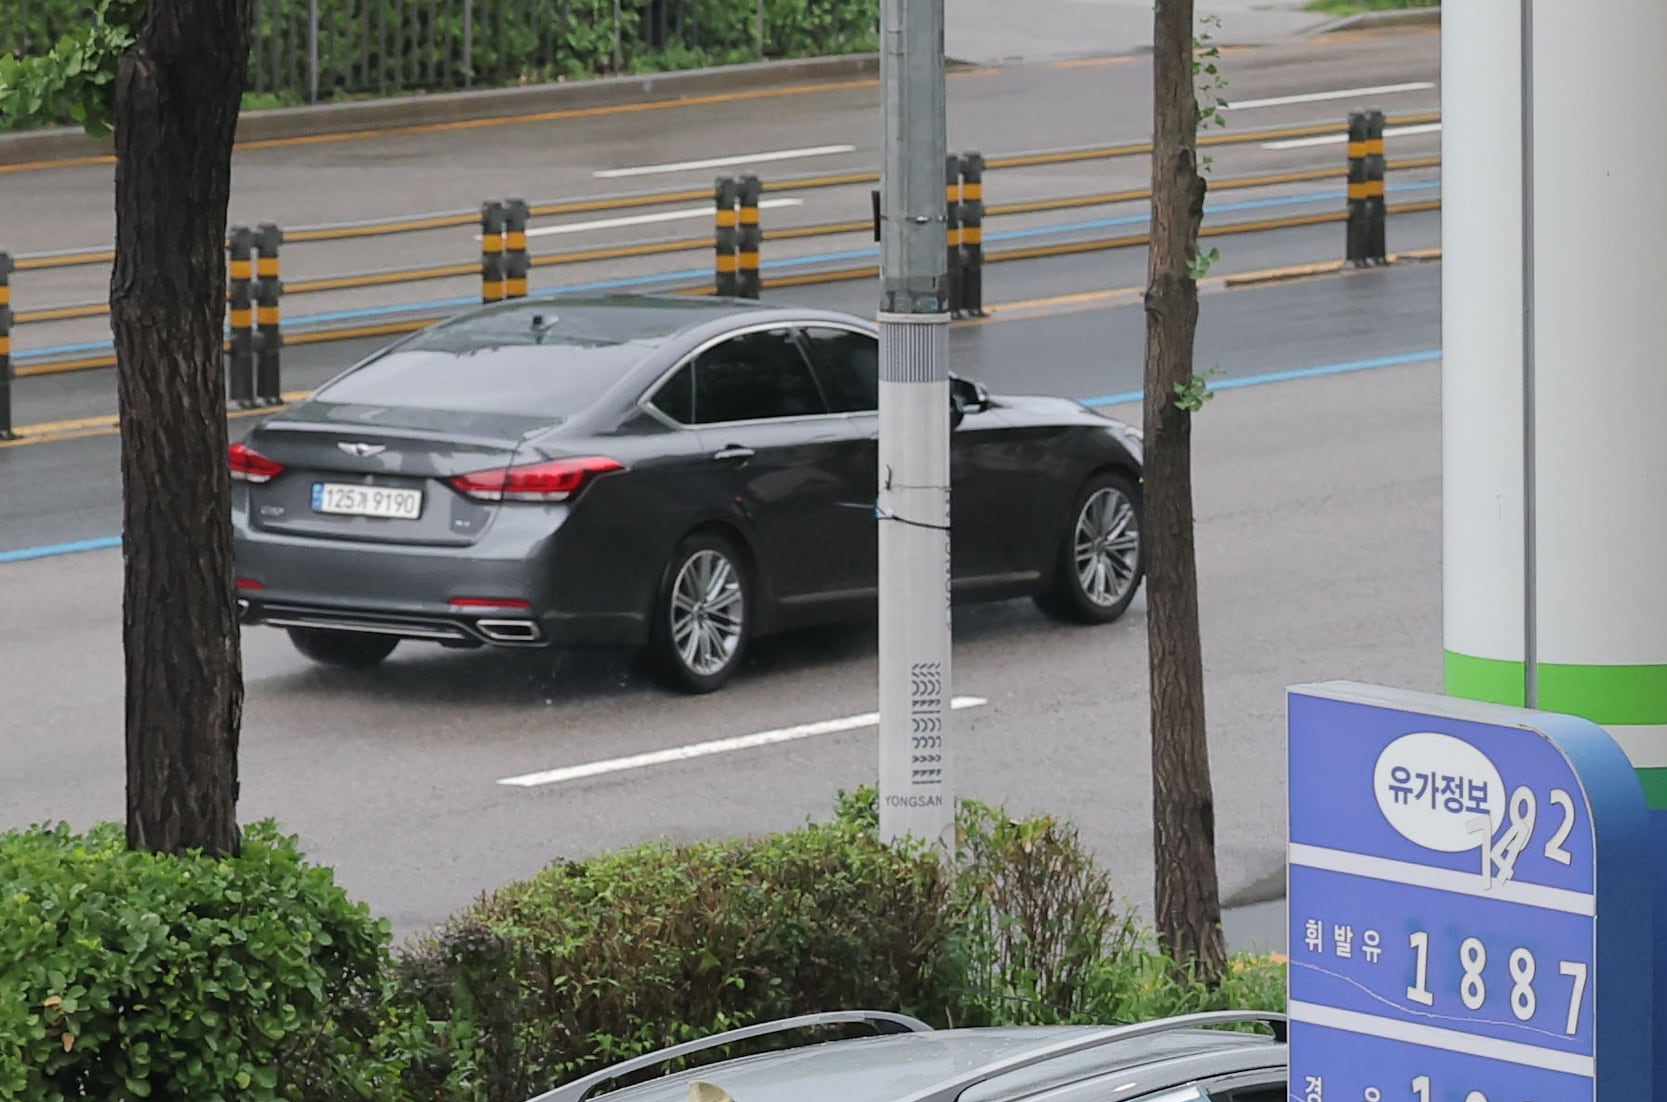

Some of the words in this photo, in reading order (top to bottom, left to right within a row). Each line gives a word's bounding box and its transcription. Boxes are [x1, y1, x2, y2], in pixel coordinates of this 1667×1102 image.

[374, 492, 417, 515] 9190
[885, 794, 943, 808] YONGSAN
[1388, 765, 1491, 816] 유가정보
[1304, 918, 1383, 964] 휘발유
[1406, 931, 1588, 1036] 1887
